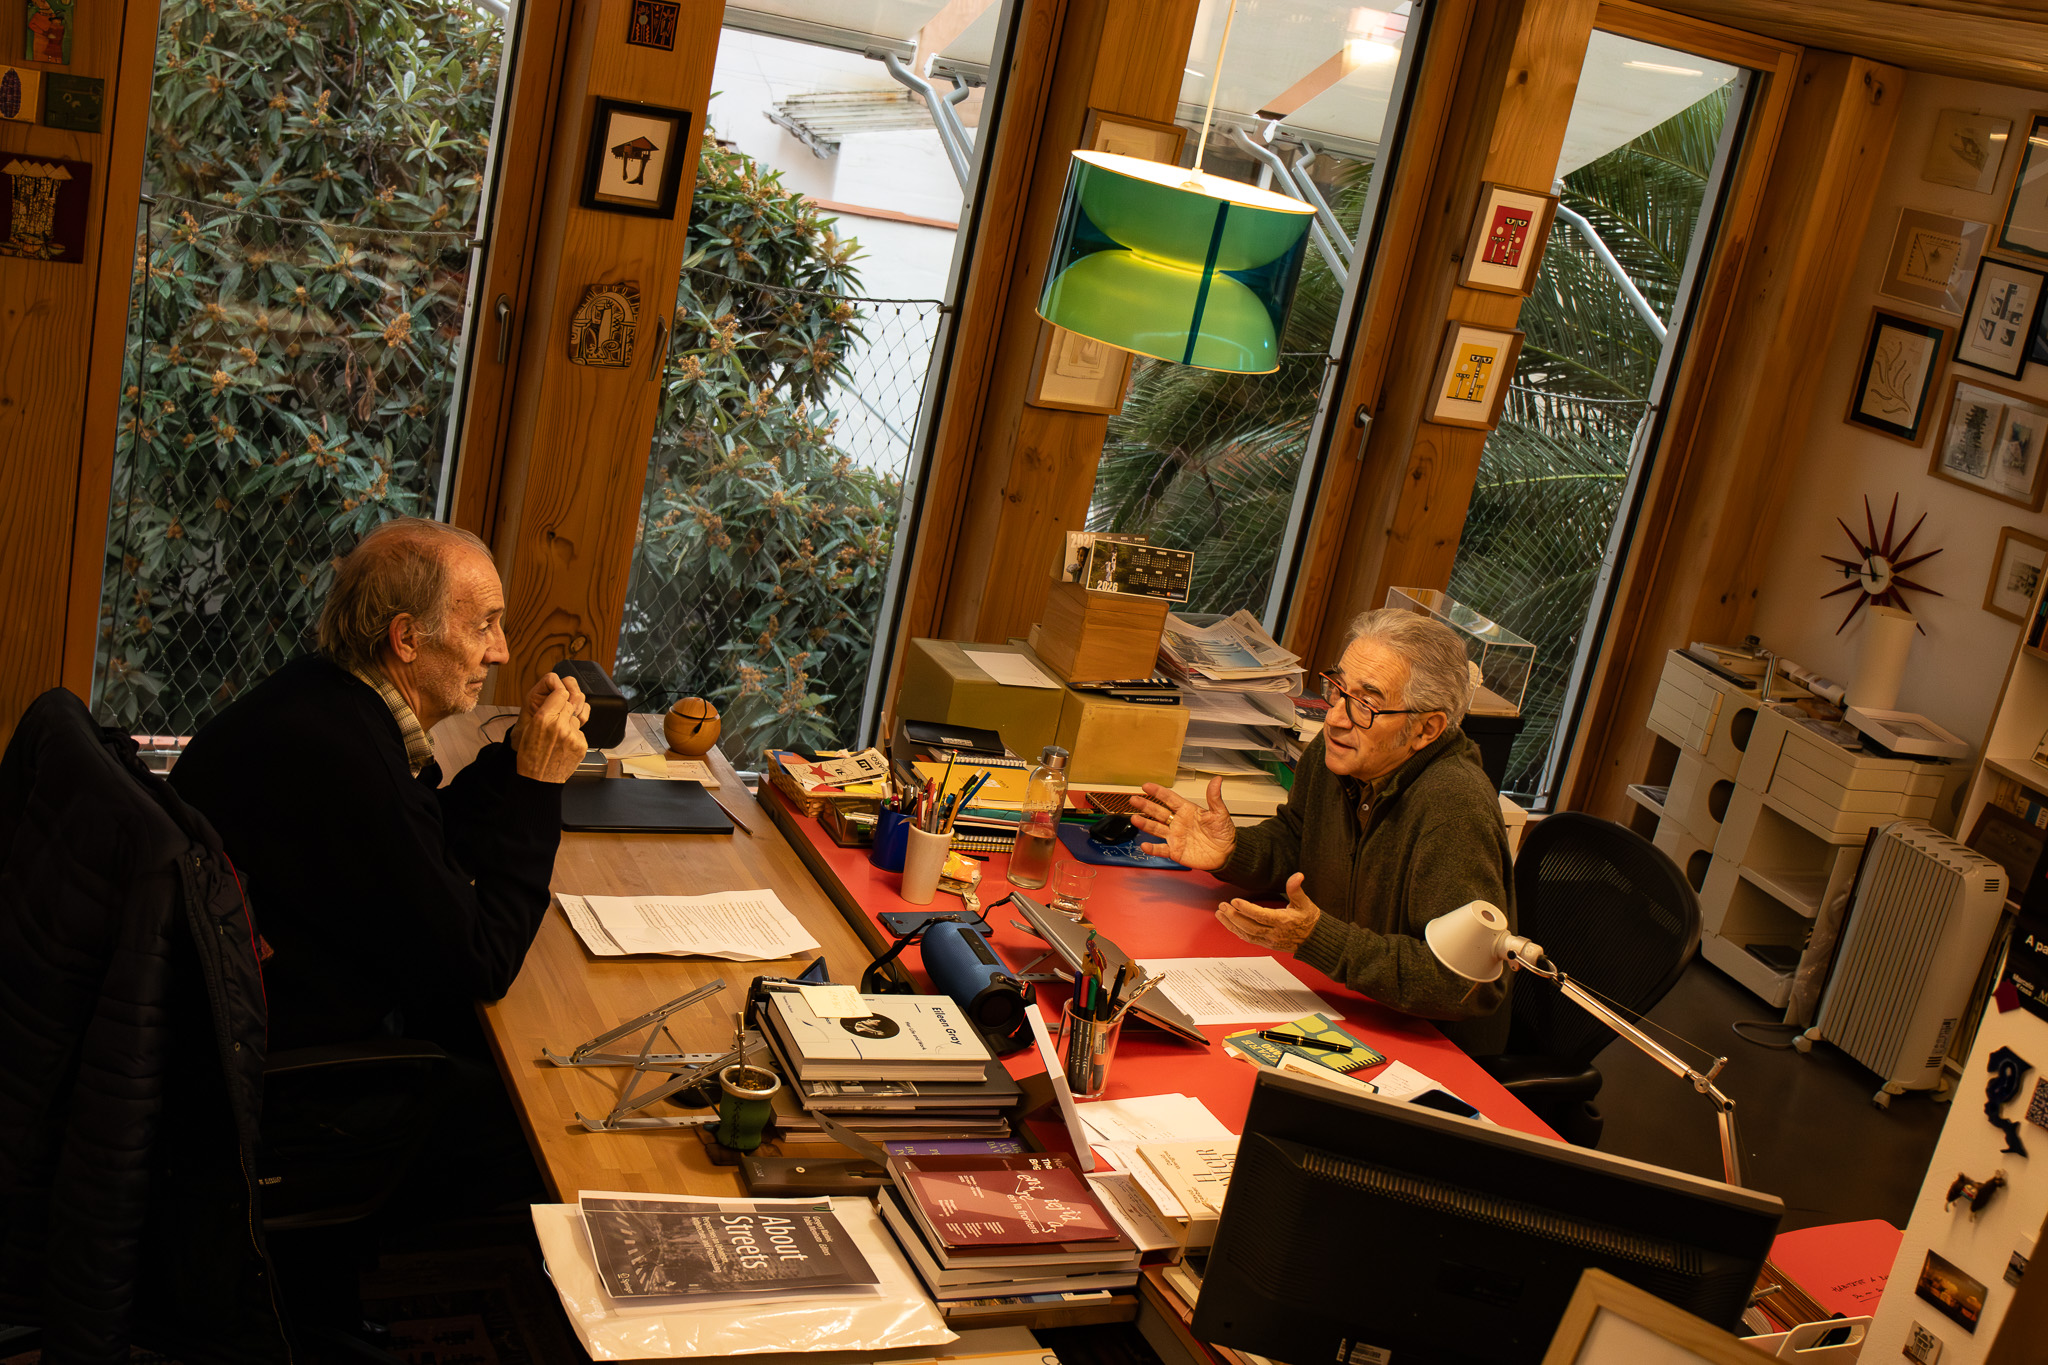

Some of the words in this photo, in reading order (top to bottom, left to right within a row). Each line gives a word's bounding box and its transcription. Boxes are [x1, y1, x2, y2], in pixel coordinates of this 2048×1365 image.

[1097, 580, 1118, 592] 2026
[2025, 935, 2034, 946] A
[932, 1007, 949, 1028] Eileen
[945, 1028, 962, 1046] Gray
[1041, 1158, 1052, 1170] The
[1196, 1149, 1232, 1186] NECER
[1006, 1194, 1016, 1202] en
[1016, 1209, 1040, 1235] frontera
[1187, 1189, 1201, 1203] David
[720, 1215, 769, 1269] Streets
[758, 1215, 809, 1261] About
